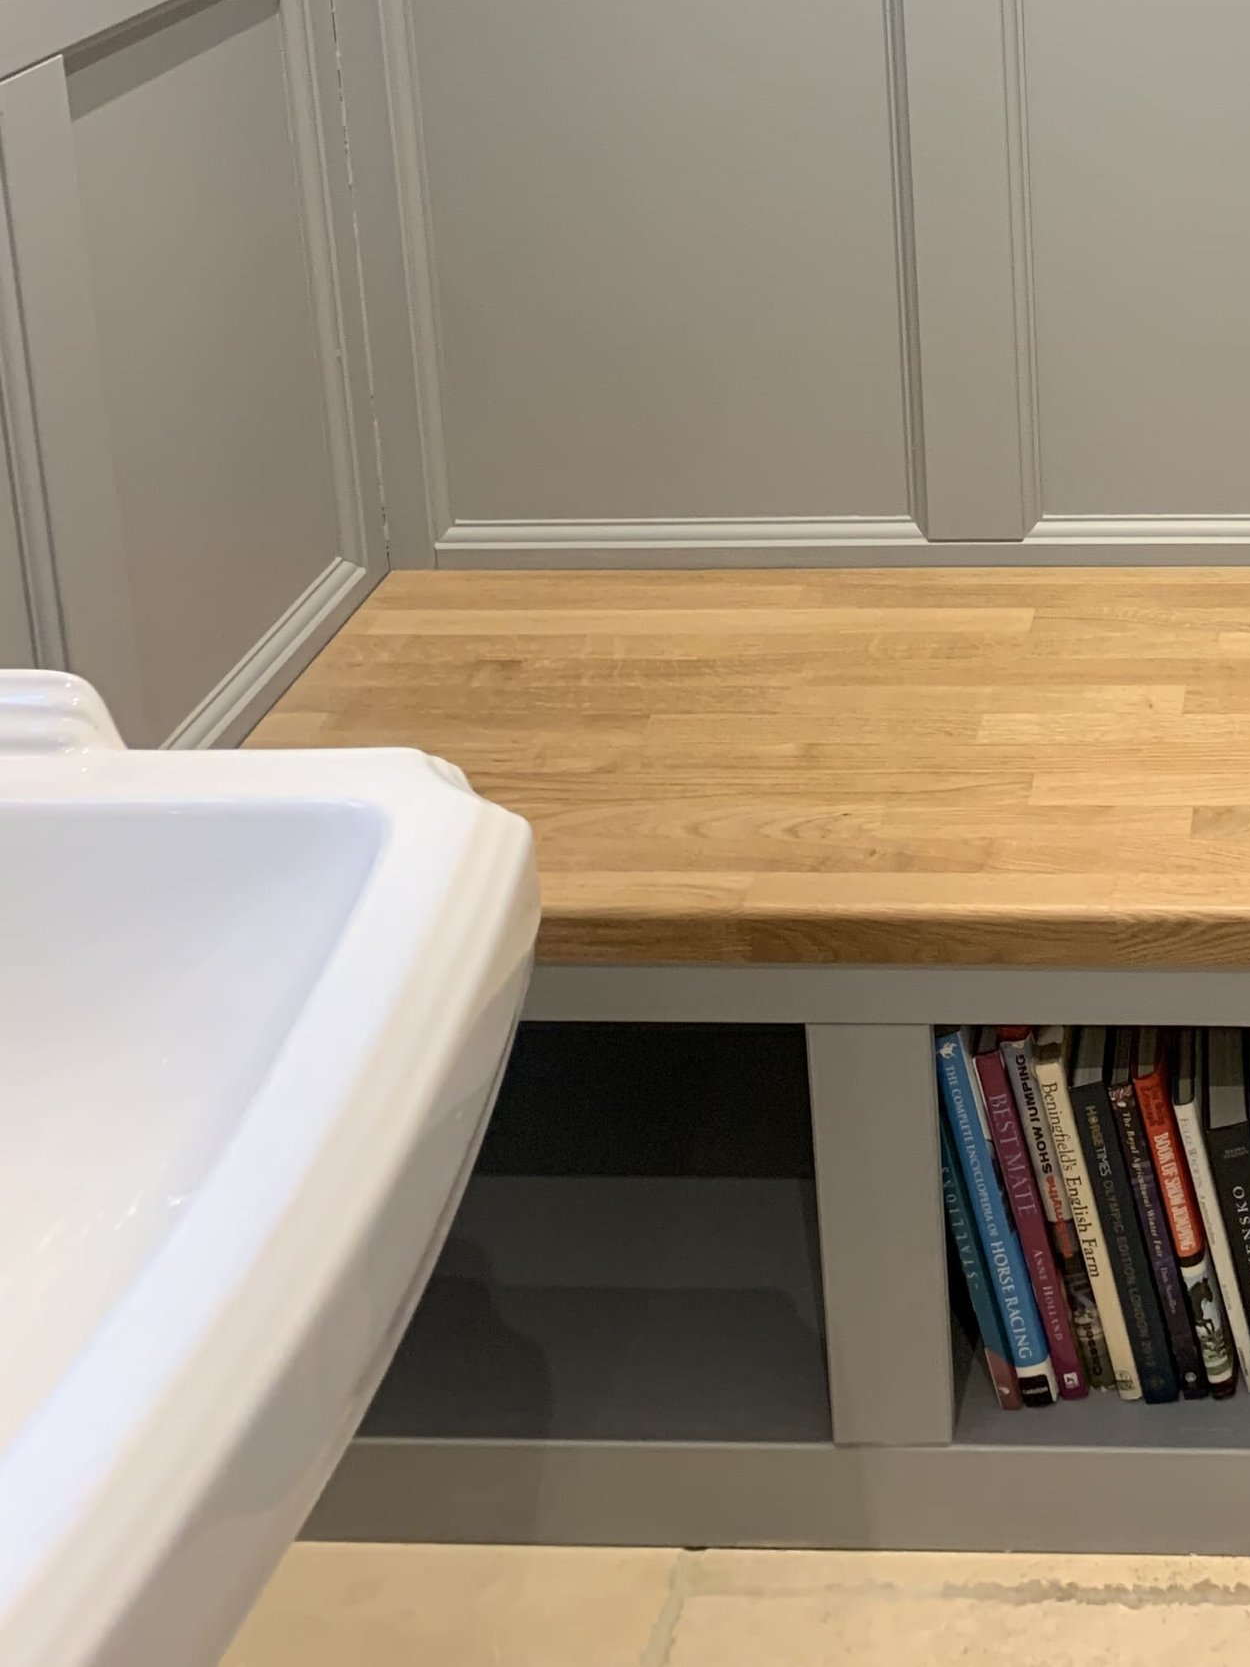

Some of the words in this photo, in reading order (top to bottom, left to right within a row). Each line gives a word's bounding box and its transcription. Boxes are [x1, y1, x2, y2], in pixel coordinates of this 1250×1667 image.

[944, 1065, 958, 1082] THE
[1015, 1053, 1041, 1123] JUMPING
[951, 1088, 974, 1143] COMPLETE
[1122, 1112, 1132, 1128] The
[988, 1093, 1020, 1151] BEST
[1004, 1154, 1039, 1217] MATE
[1031, 1126, 1053, 1175] SHOW
[1127, 1130, 1140, 1155] Royal
[1153, 1131, 1174, 1163] BOOK
[966, 1144, 995, 1223] ENCYCLOPEDIA
[1041, 1082, 1078, 1172] Beningfield's
[1066, 1176, 1093, 1234] English
[1081, 1236, 1101, 1278] Farm
[1133, 1156, 1152, 1208] Agricultural
[1162, 1163, 1178, 1177] OF
[1164, 1177, 1187, 1205] SHOW
[986, 1223, 998, 1238] OF
[1103, 1179, 1125, 1233] OLYMPIC
[1117, 1234, 1138, 1285] EDITION
[1147, 1209, 1160, 1238] Winter
[1171, 1205, 1197, 1251] JUMPING
[990, 1240, 1016, 1297] HORSE
[1153, 1240, 1164, 1259] Fair
[1005, 1297, 1034, 1360] RACING
